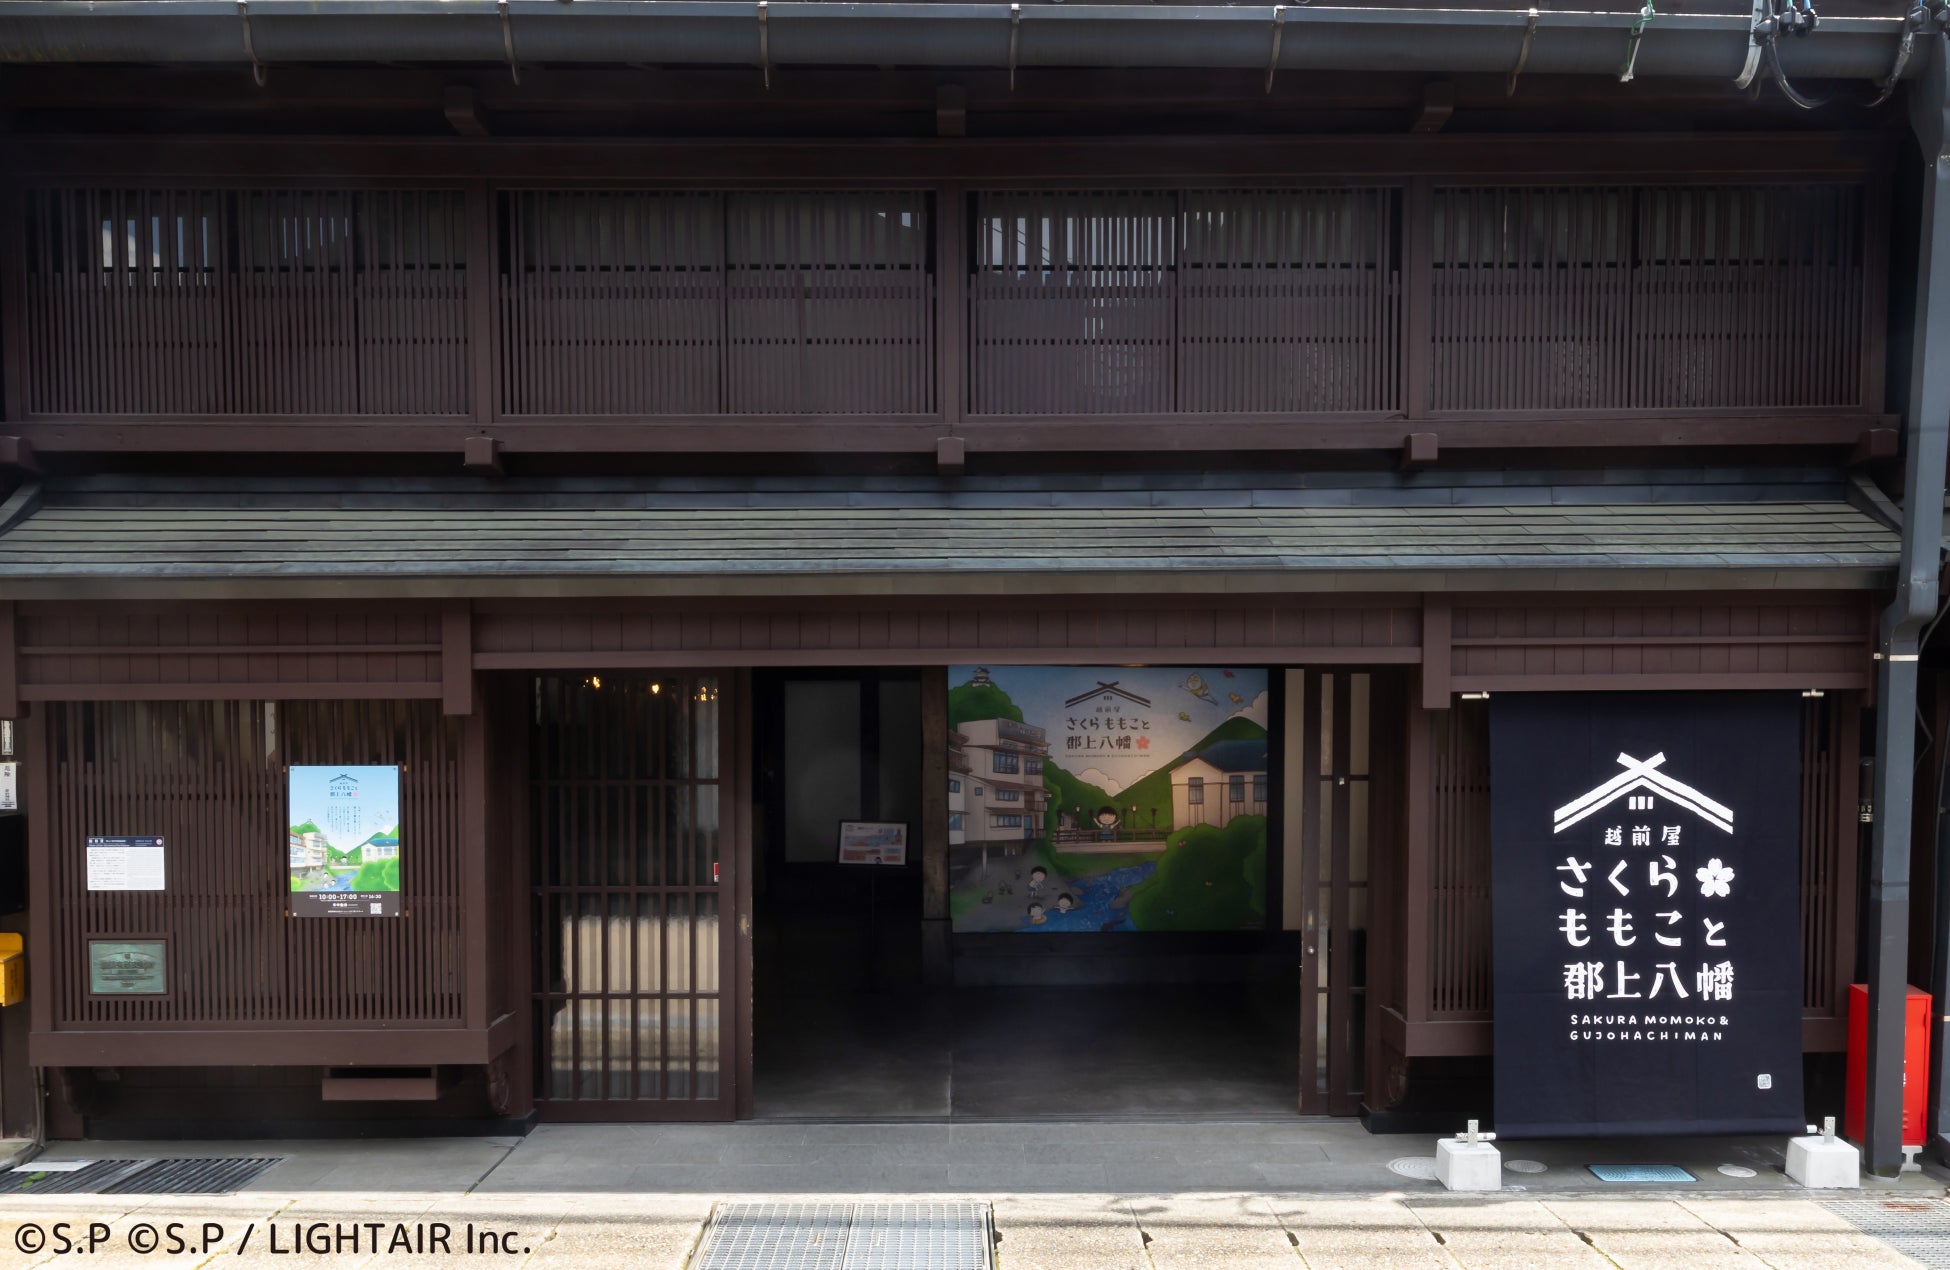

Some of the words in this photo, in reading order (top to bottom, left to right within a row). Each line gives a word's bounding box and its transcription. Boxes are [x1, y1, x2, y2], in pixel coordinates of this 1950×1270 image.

[1066, 735, 1132, 750] 郡上八幡
[1604, 824, 1682, 847] 越前屋
[1556, 855, 1679, 898] さくら
[1558, 907, 1727, 948] ももこと
[1563, 961, 1735, 1002] 郡上八幡
[1570, 1014, 1638, 1026] SAKURA
[1570, 1030, 1722, 1042] GUJOHACHIMAN
